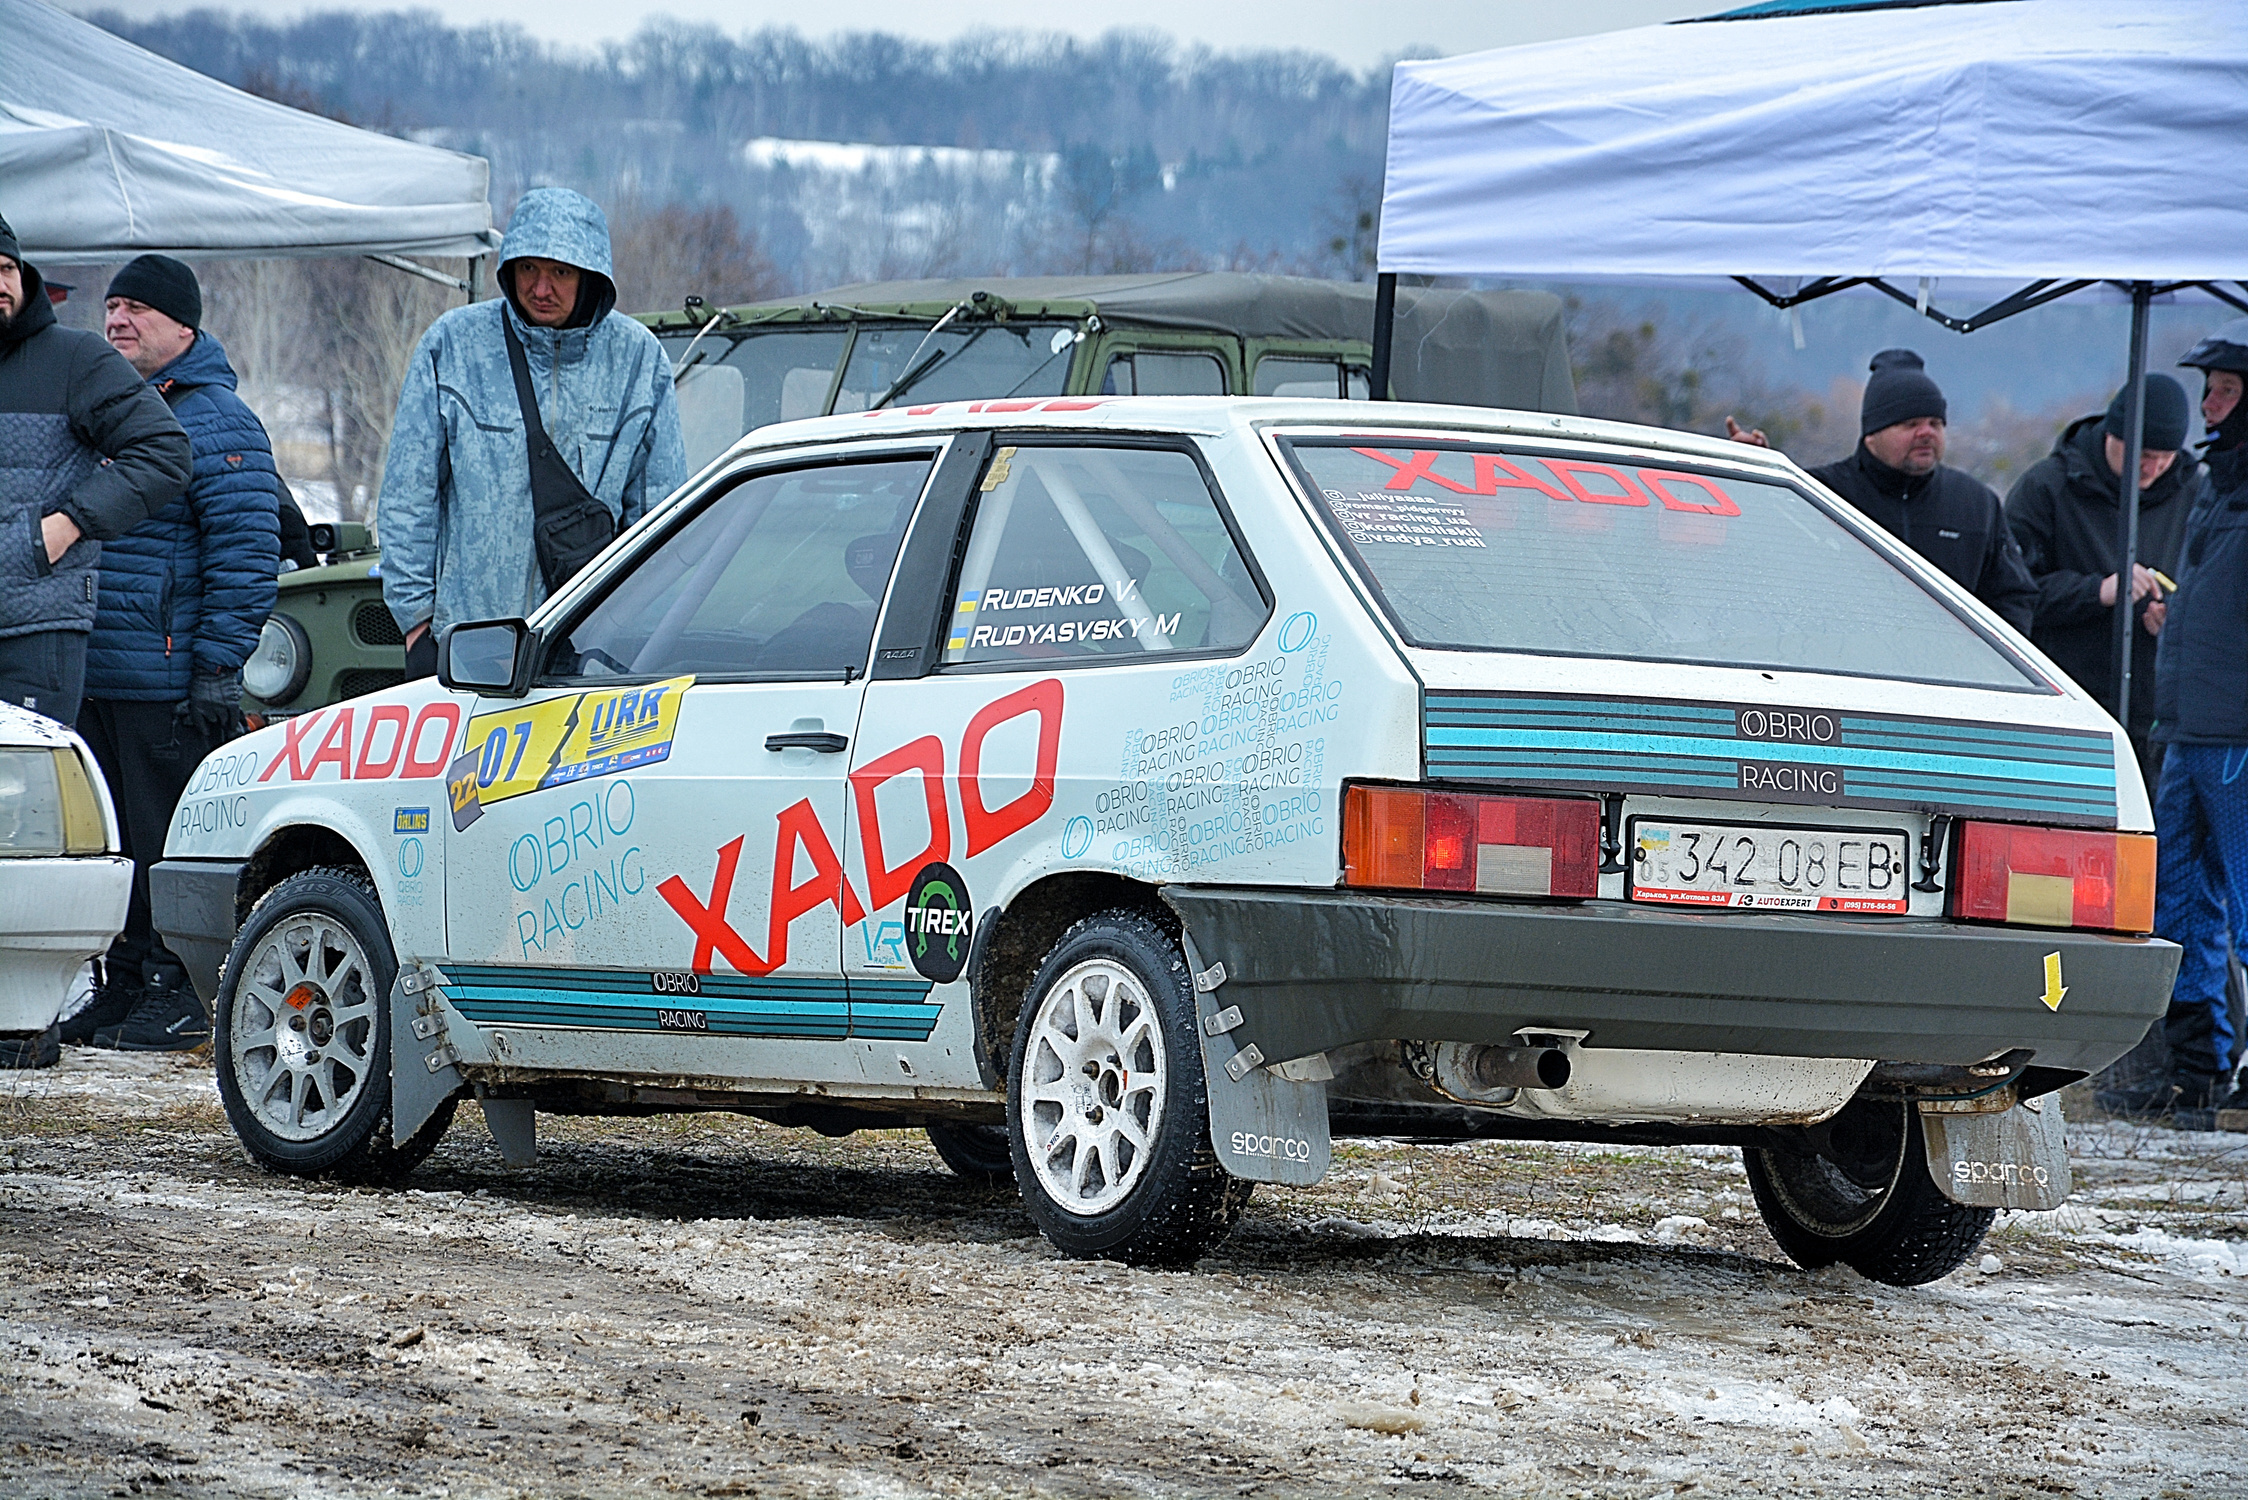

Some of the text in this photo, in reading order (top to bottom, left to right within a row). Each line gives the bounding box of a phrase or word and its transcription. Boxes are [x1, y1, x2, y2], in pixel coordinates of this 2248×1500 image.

[1350, 447, 1742, 518] XADO
[981, 583, 1105, 612] RUDENKO
[1153, 612, 1182, 636] M
[1225, 656, 1286, 690] OBRIO
[1221, 679, 1283, 711] RACING
[1279, 680, 1342, 712] OBRIO
[1201, 701, 1261, 735] OBRIO
[1275, 703, 1339, 735] RACING
[1741, 710, 1834, 741] OBRIO
[257, 702, 461, 782] XADO
[1140, 721, 1198, 754] OBRIO
[1198, 725, 1258, 758] RACING
[478, 721, 532, 789] 07
[1138, 744, 1196, 777] RACING
[1242, 743, 1302, 774] OBRIO
[450, 771, 477, 813] 22
[1166, 762, 1224, 793] OBRIO
[1239, 767, 1300, 798] RACING
[1743, 766, 1837, 794] RACING
[1095, 781, 1148, 814] OBRIO
[1167, 785, 1223, 816] RACING
[1262, 791, 1321, 826] OBRIO
[179, 795, 248, 839] RACING
[396, 810, 428, 830] ÖHLINS
[655, 678, 1065, 977] XADO
[1097, 805, 1151, 837] RACING
[1188, 811, 1243, 845] OBRIO
[1264, 816, 1324, 849] RACING
[508, 779, 635, 892] OBRIO
[1112, 830, 1171, 862] OBRIO
[1189, 836, 1246, 870] RACING
[1678, 833, 1756, 886] 342
[1640, 860, 1670, 883] 05
[517, 846, 645, 961] RACING
[1757, 897, 1812, 908] AUTOEXPERT
[907, 906, 971, 936] TIREX
[653, 972, 699, 993] OBRIO
[659, 1010, 706, 1029] RACING
[1231, 1131, 1310, 1159] sparco
[1954, 1160, 2049, 1188] sparco
